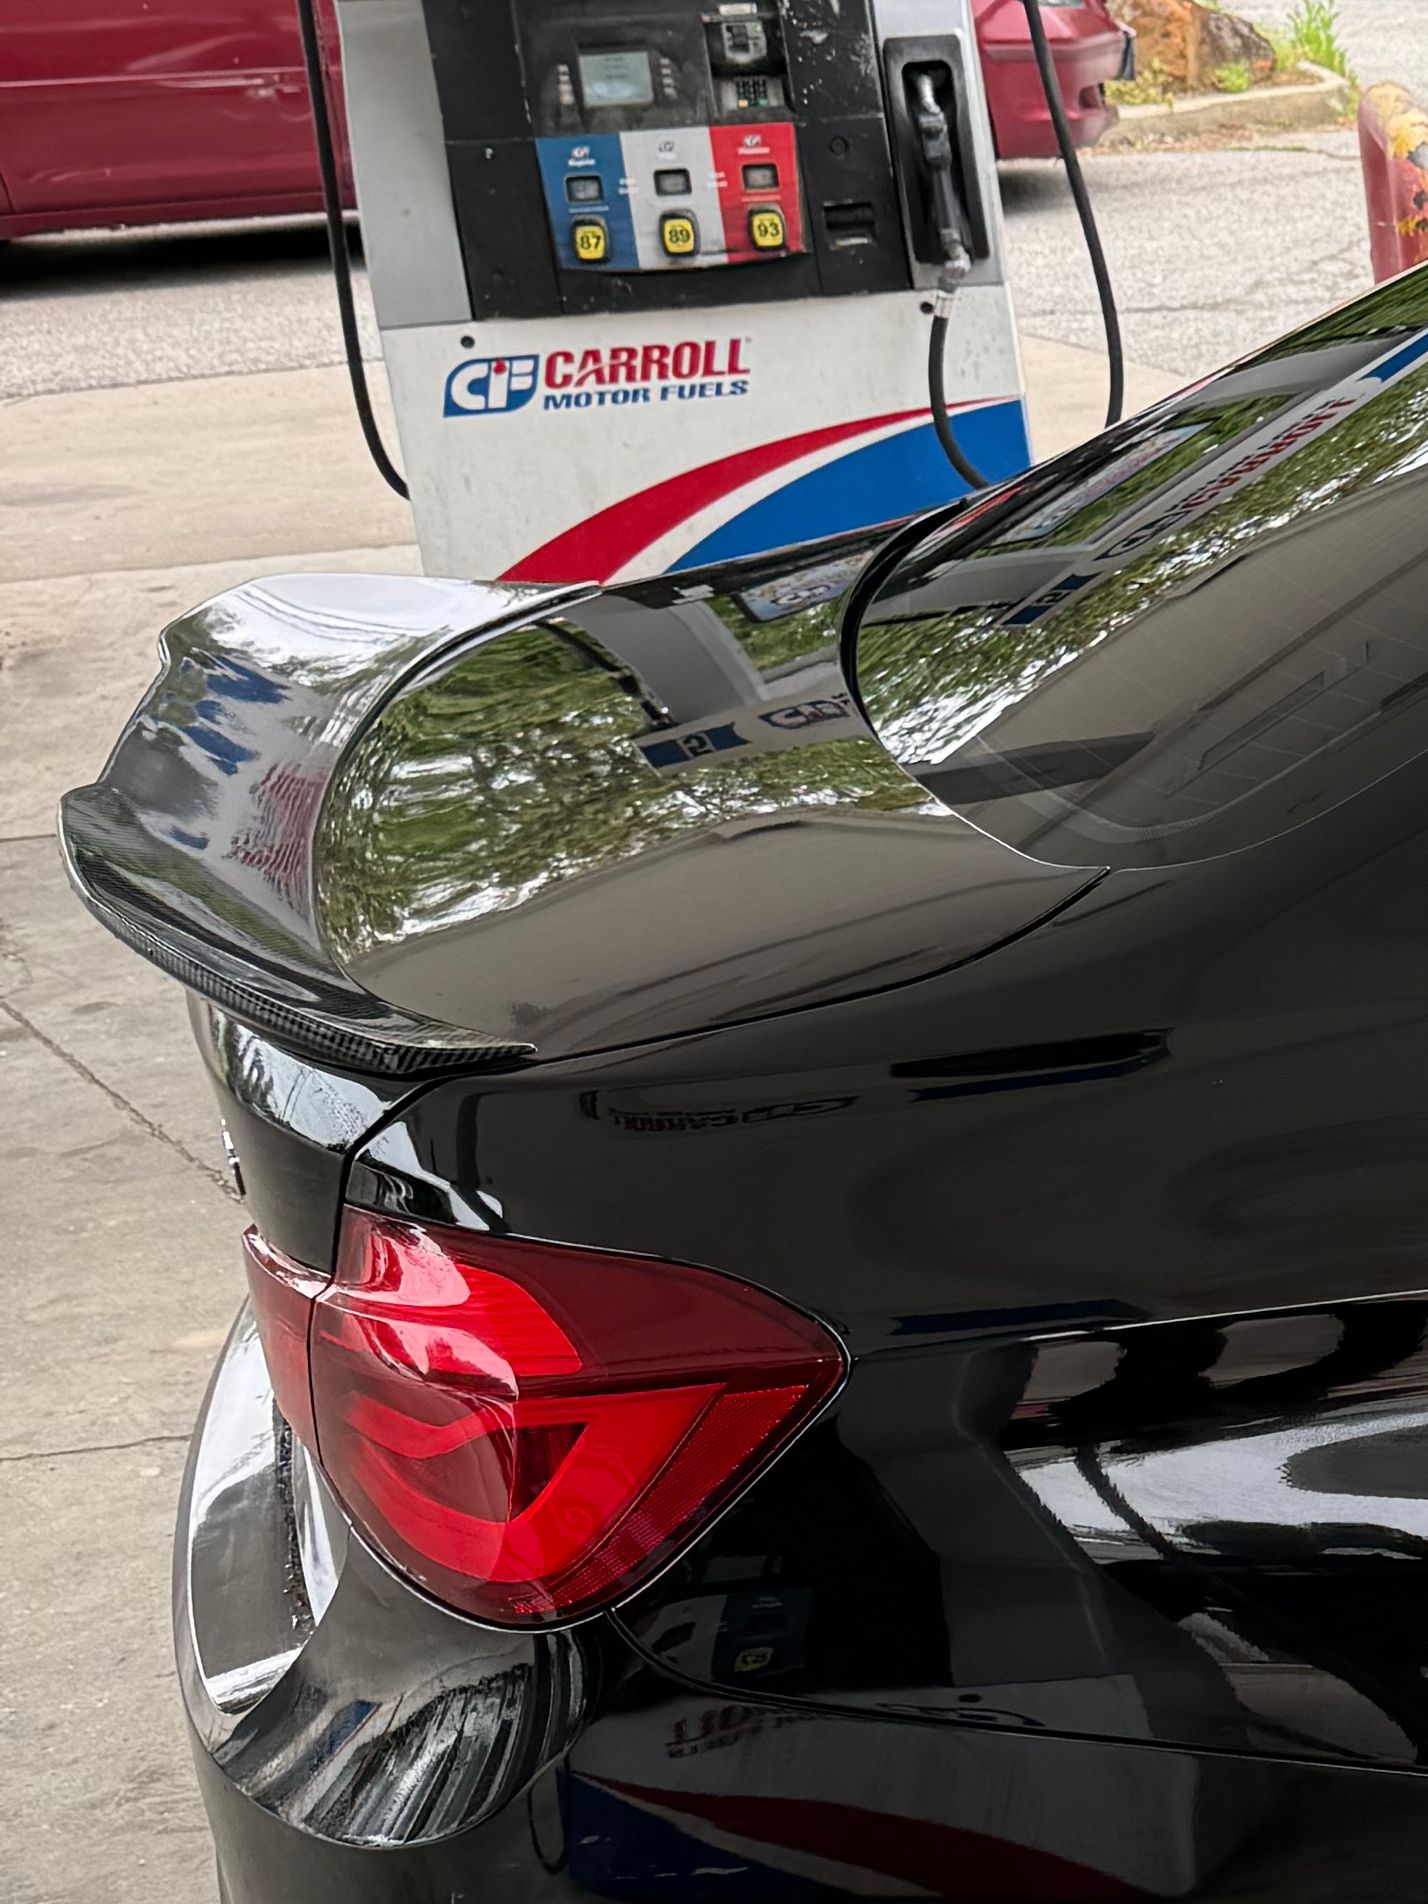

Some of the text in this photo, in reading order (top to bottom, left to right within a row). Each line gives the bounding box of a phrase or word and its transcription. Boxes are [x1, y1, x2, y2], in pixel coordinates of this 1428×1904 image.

[667, 228, 691, 245] 89
[756, 221, 780, 238] 93
[580, 234, 602, 250] 87
[545, 339, 750, 388] CARROLL
[544, 379, 748, 410] MOTOR FUELS
